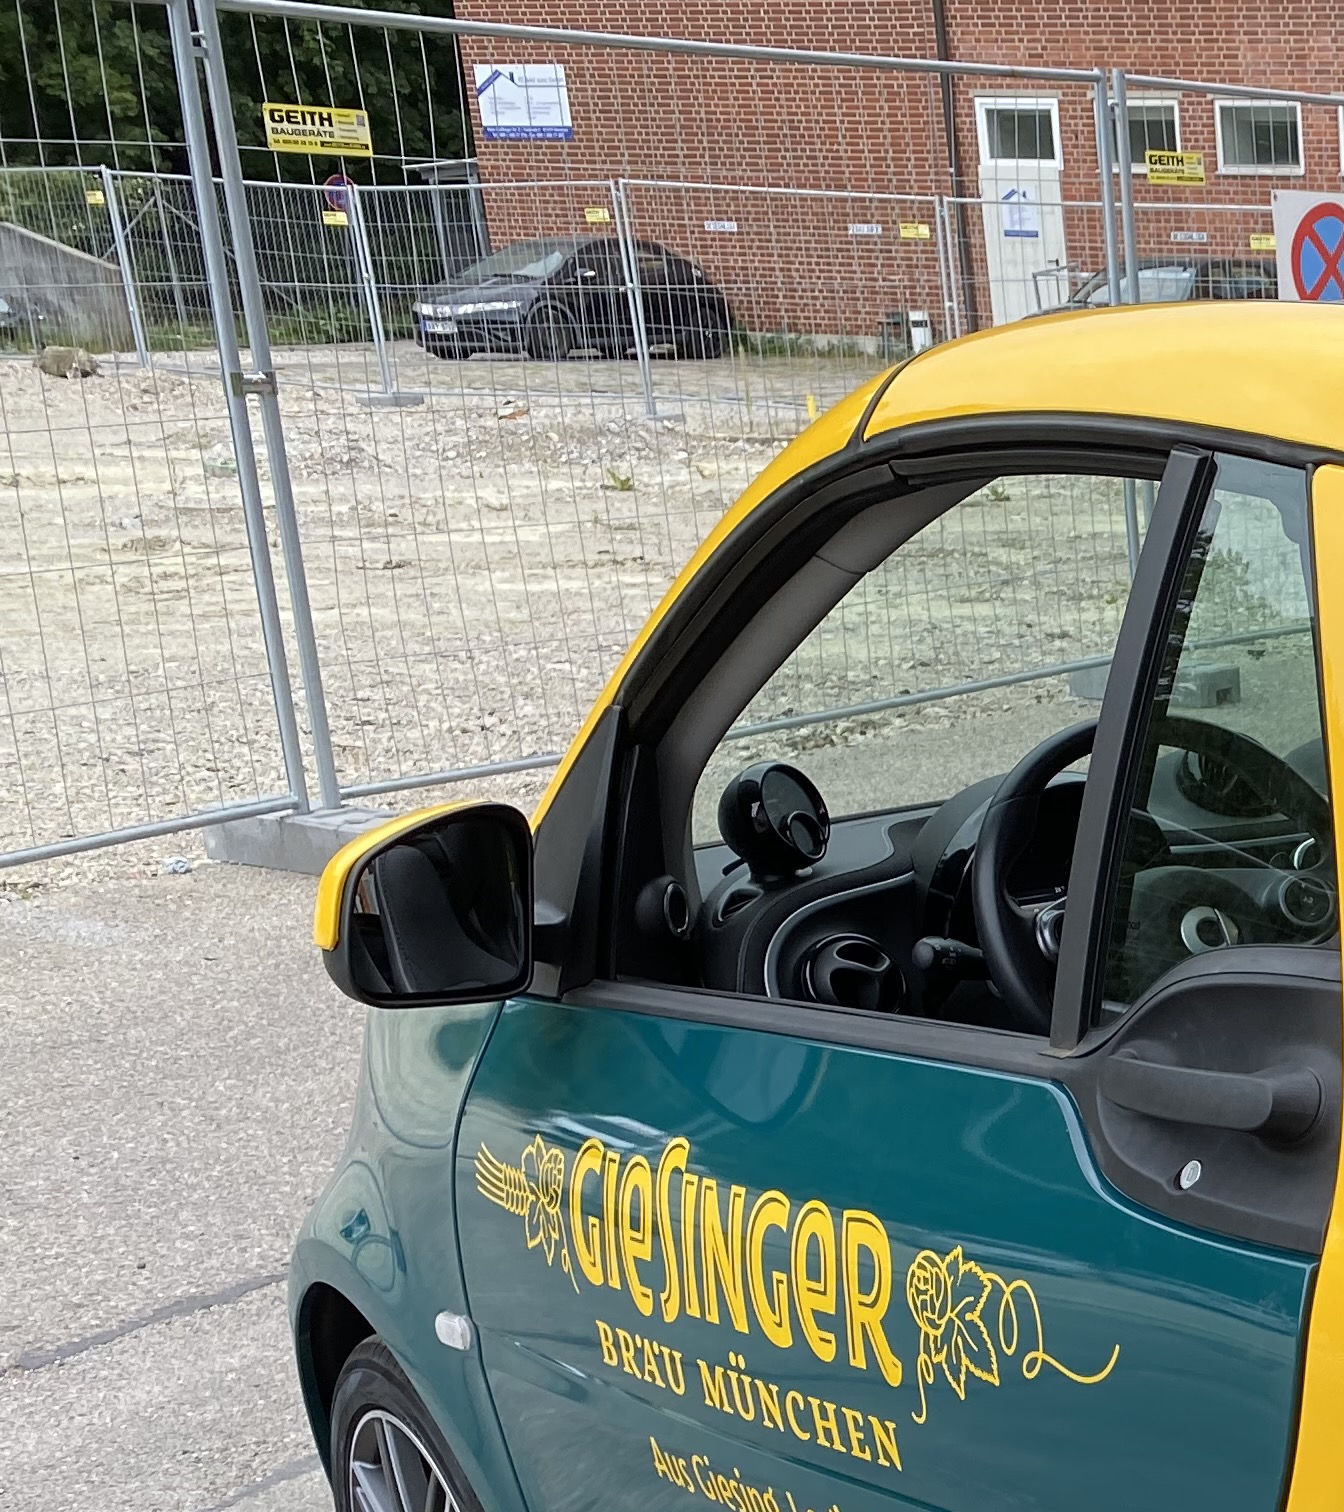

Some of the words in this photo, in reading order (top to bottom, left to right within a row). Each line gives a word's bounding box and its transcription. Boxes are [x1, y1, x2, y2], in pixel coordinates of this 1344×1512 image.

[268, 107, 334, 127] GEITH
[1148, 154, 1185, 167] GEITH
[595, 1320, 687, 1396] BRÄU
[698, 1351, 904, 1473] MÜNCHEN
[649, 1435, 696, 1494] Aus
